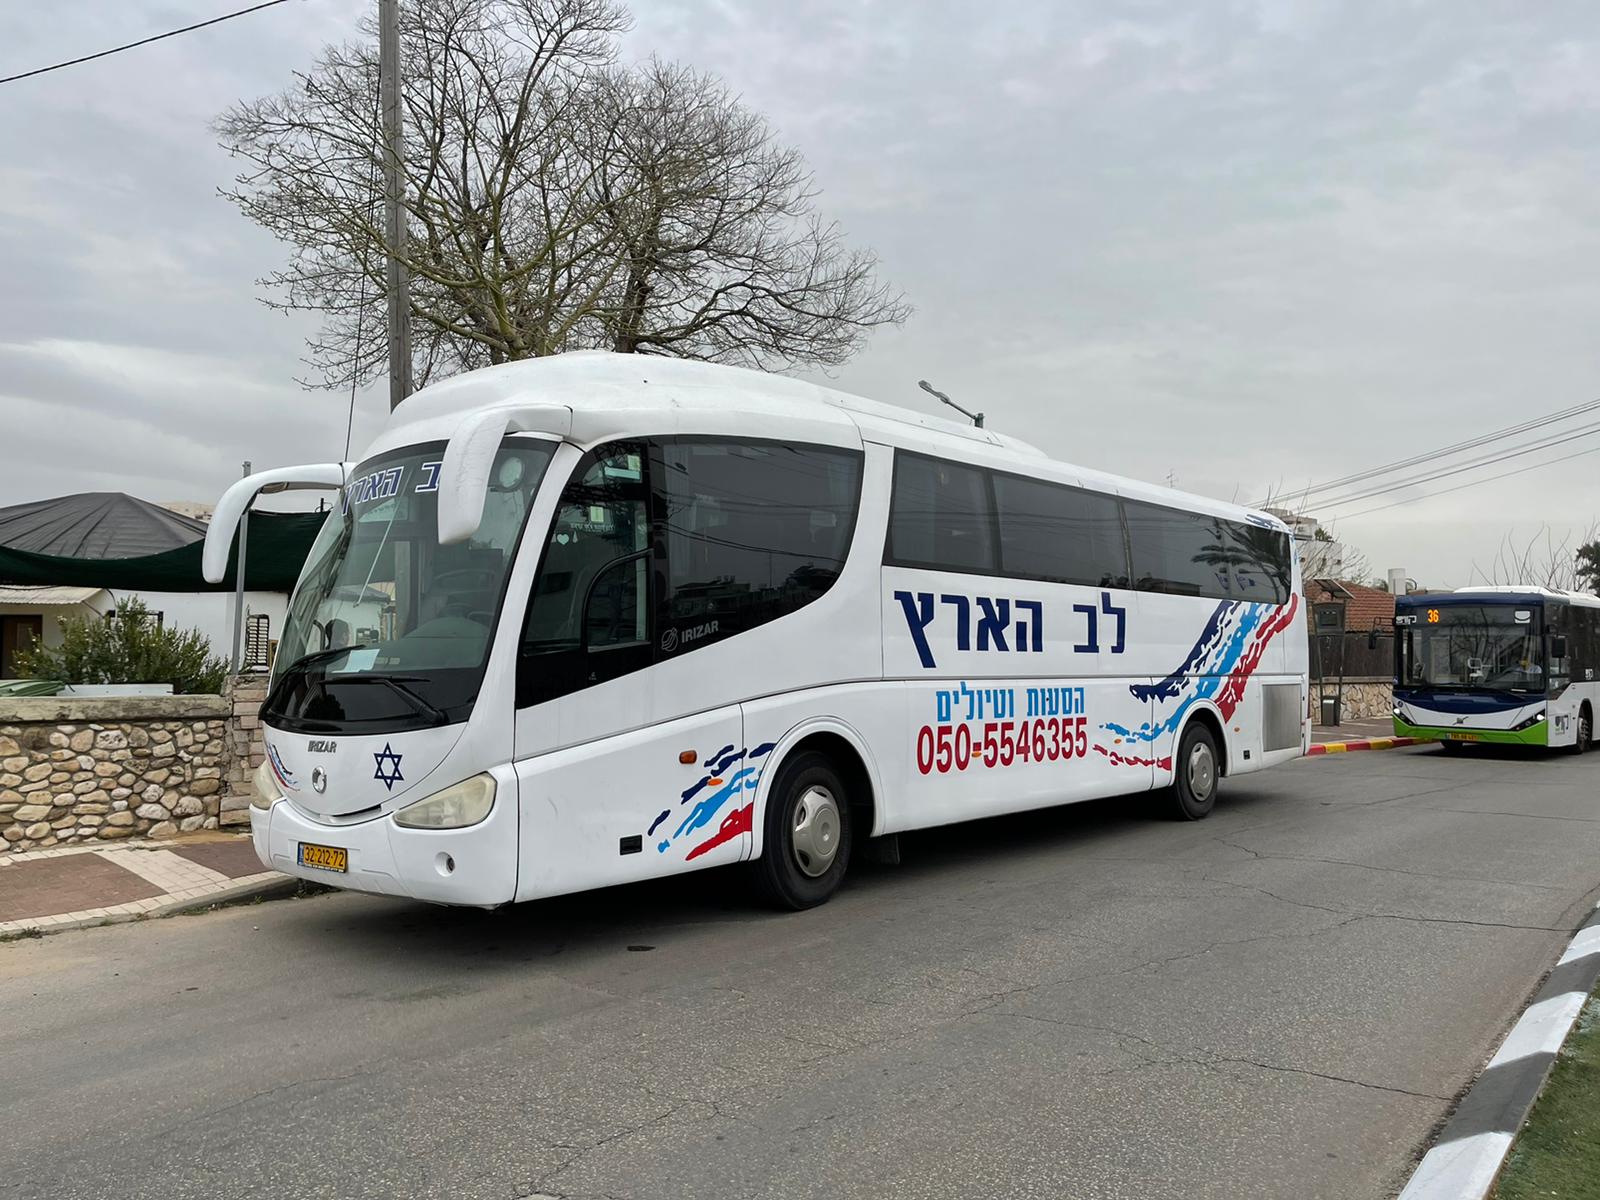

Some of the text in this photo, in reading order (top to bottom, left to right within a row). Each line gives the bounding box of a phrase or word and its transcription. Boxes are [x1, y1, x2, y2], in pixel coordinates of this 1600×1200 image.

[342, 461, 443, 516] ב הארץ
[681, 620, 719, 643] IRIZAR
[894, 590, 1126, 669] לב הארץ
[1427, 609, 1439, 623] 36
[935, 681, 1085, 722] הסעות וטיולים
[307, 740, 337, 753] IRIZAR
[917, 717, 1088, 775] 050-5546355
